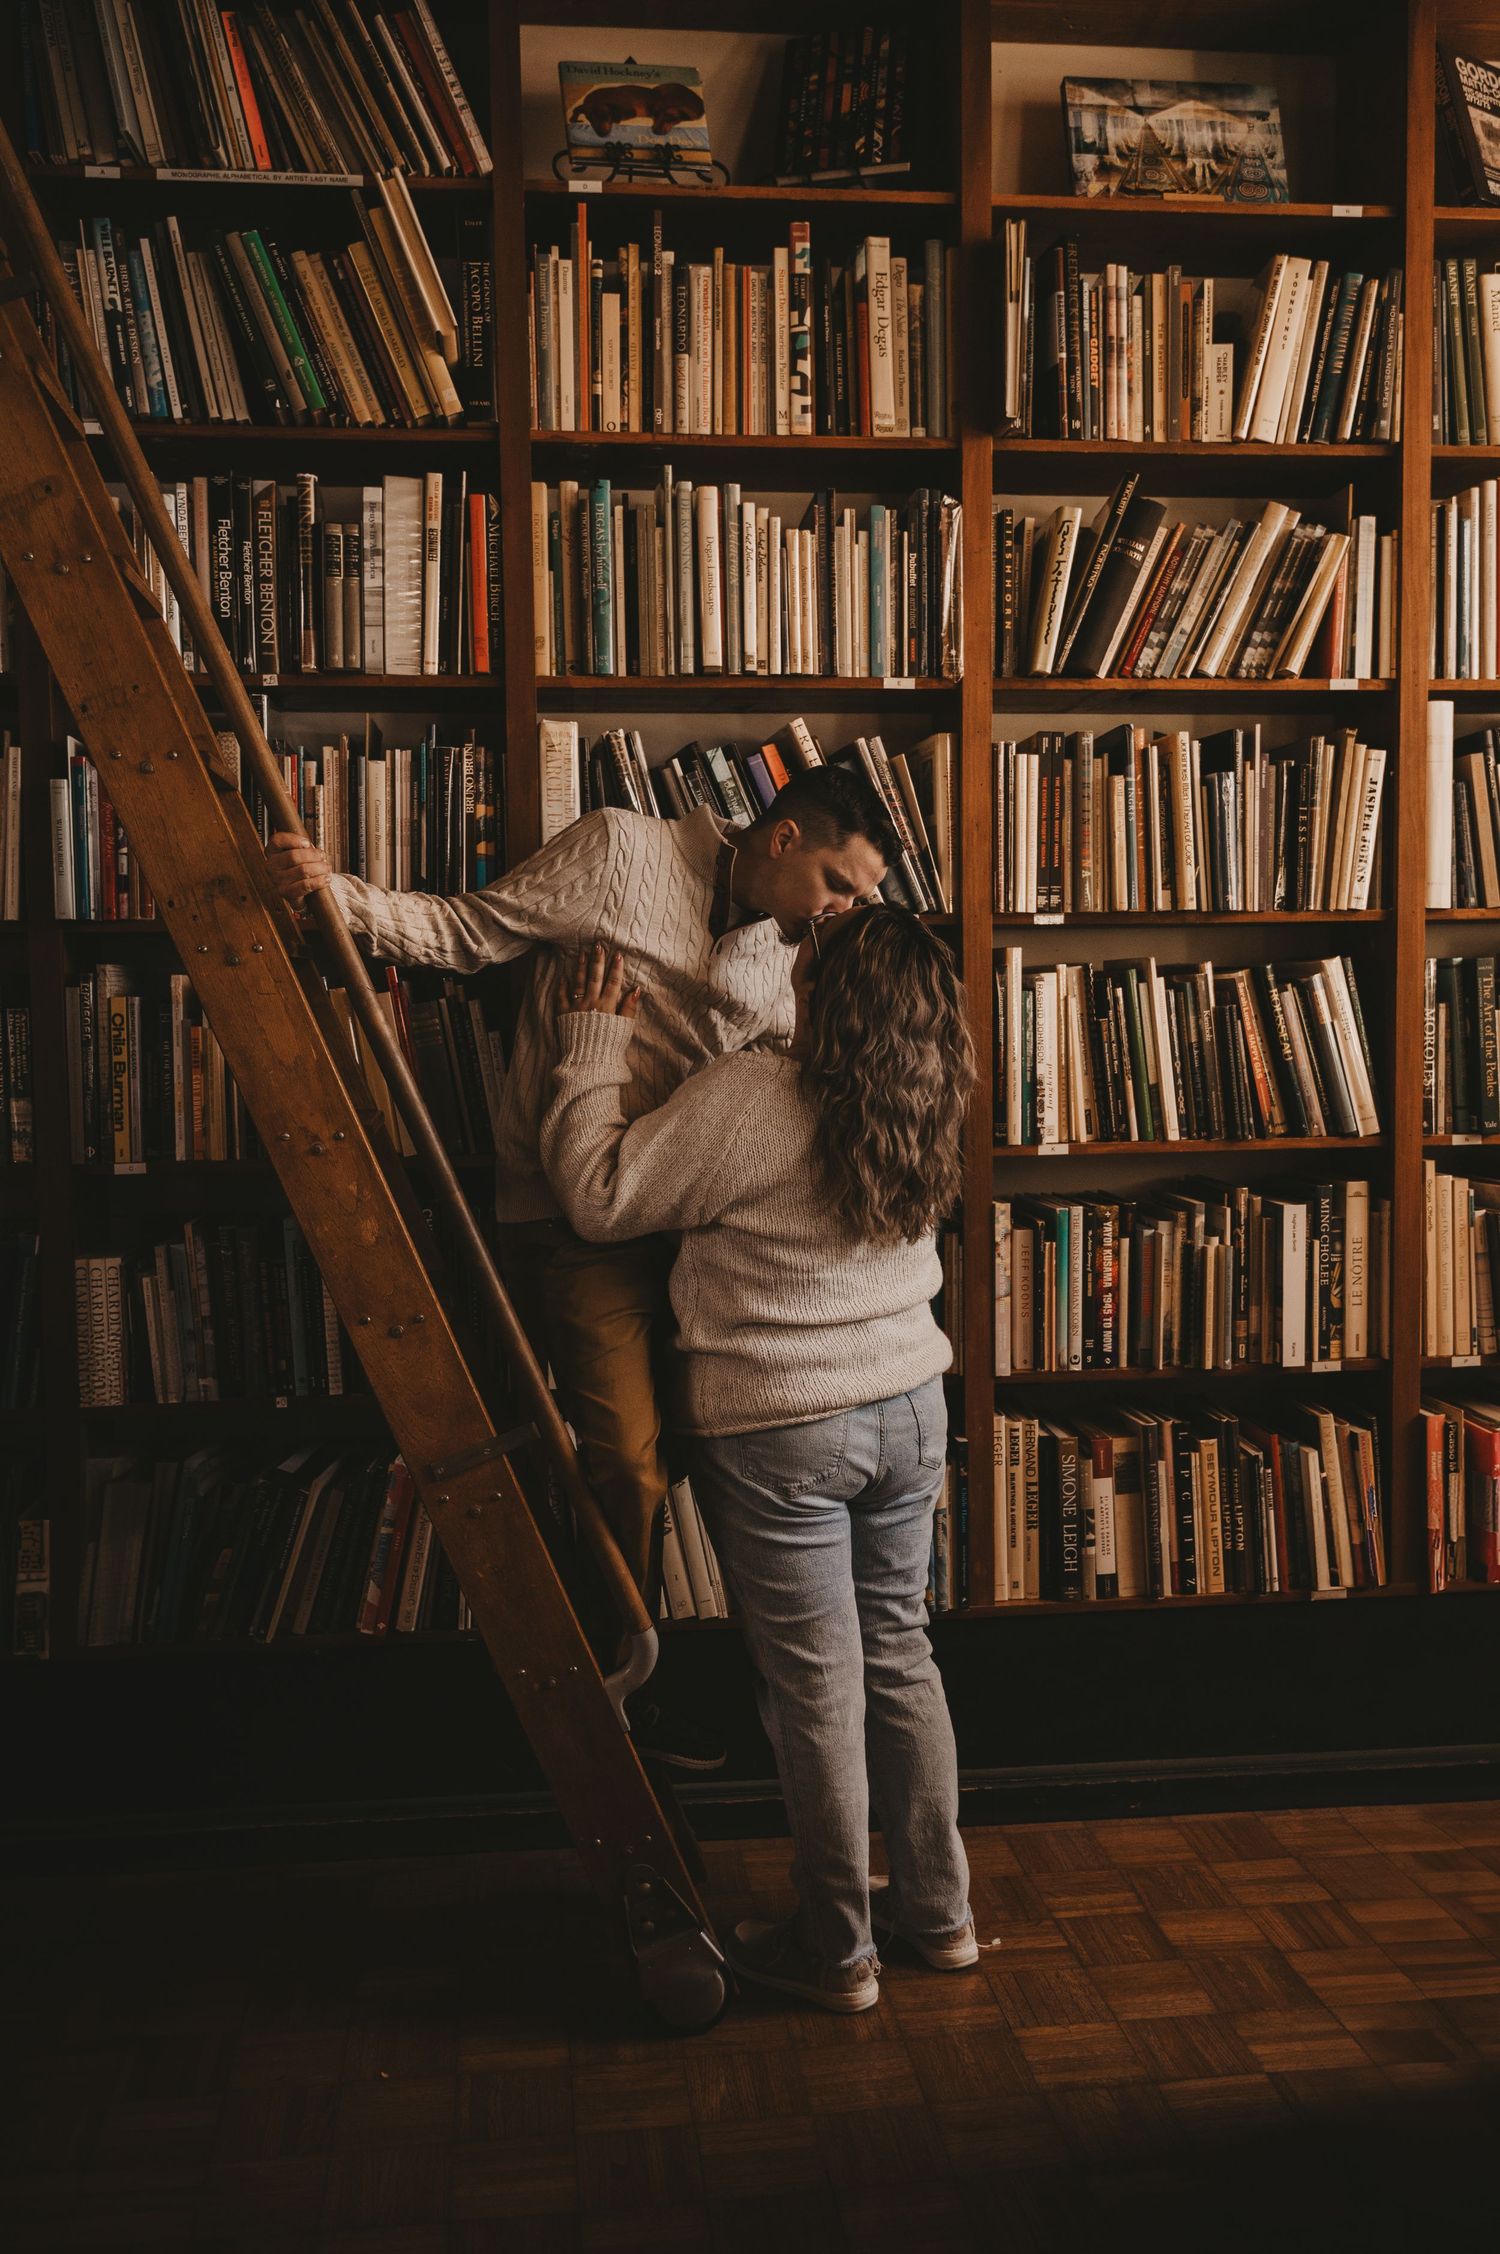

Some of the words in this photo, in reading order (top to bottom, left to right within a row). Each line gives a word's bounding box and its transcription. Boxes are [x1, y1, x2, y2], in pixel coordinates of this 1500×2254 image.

[566, 66, 601, 76] David
[605, 66, 661, 83] Hockney's
[98, 224, 114, 249] WILL
[102, 250, 119, 297] BARNET
[468, 260, 483, 311] JACOPO
[482, 261, 490, 276] THE
[540, 262, 550, 302] Daumier
[561, 266, 569, 295] Daumier
[778, 268, 787, 295] Stuart
[1067, 242, 1080, 317] FREDERICK
[1272, 263, 1284, 277] THE
[1447, 264, 1460, 307] MANET
[1464, 264, 1477, 307] MANET
[482, 278, 491, 310] GENIUS
[760, 278, 768, 303] DAVIS'S
[872, 272, 888, 312] Edgar
[1267, 279, 1280, 300] MOST
[483, 311, 491, 323] OF
[676, 285, 687, 352] LEONARDO
[760, 305, 768, 340] ABSTRACT
[778, 297, 787, 322] Davis
[1260, 313, 1272, 335] JOHN
[1265, 301, 1274, 313] OF
[1280, 271, 1300, 352] SOUNDINGS
[1490, 289, 1500, 333] Manet
[471, 315, 484, 368] BELLINI
[540, 305, 552, 350] Drawings
[779, 323, 787, 360] American
[874, 316, 890, 358] Degas
[1070, 320, 1081, 362] HART
[1158, 322, 1166, 342] Tim
[1385, 304, 1398, 350] HOKUSAI'S
[760, 341, 768, 365] ARGOT
[1255, 335, 1267, 356] HELD
[779, 361, 788, 391] Painter
[1158, 348, 1166, 393] Hawkinson
[1381, 352, 1393, 409] LANDSCAPES
[680, 497, 691, 514] DE
[1115, 479, 1136, 516] HOGARTH
[298, 479, 314, 566] BERNINI
[532, 512, 541, 538] EDGAR
[552, 519, 560, 541] Degas
[594, 502, 606, 541] DEGAS
[217, 518, 234, 570] Fletcher
[242, 540, 254, 573] Fletcher
[488, 522, 502, 580] MICHAEL
[532, 541, 541, 568] DEGAS
[594, 543, 607, 554] by
[680, 518, 693, 575] KOONING
[704, 535, 716, 562] Degas
[596, 556, 609, 592] himself
[908, 552, 918, 588] Dubuffet
[1004, 515, 1015, 631] HIRSHHORN
[1086, 543, 1111, 590] ENGRAVINGS
[168, 586, 178, 621] andscape
[218, 570, 234, 619] Benton
[243, 573, 255, 606] Benton
[488, 583, 502, 622] BIRCH
[706, 565, 718, 617] Landscapes
[909, 588, 917, 598] as
[909, 599, 918, 630] architect
[463, 743, 475, 774] BRUNI
[545, 739, 564, 808] MARCEL
[463, 776, 475, 815] BRUNO
[944, 759, 956, 821] Impossible
[1040, 776, 1048, 787] THE
[1053, 776, 1061, 787] THE
[1040, 788, 1048, 818] ESSENTIAL
[1053, 788, 1061, 818] ESSENTIAL
[1127, 787, 1137, 823] INGRES
[1362, 778, 1379, 833] JASPER
[56, 818, 65, 850] WILLIAM
[1040, 820, 1048, 842] ROBERT
[1053, 820, 1061, 842] ROBERT
[1159, 800, 1167, 841] HIDEAWAYS
[1298, 806, 1308, 845] JESS
[947, 824, 957, 863] Worlds
[1040, 843, 1048, 869] INDIANA
[1053, 843, 1061, 868] INDIANA
[1355, 836, 1372, 885] JOHNS
[57, 851, 66, 877] BIRCH
[1036, 983, 1045, 1019] RASHID
[1237, 981, 1250, 1007] Sarah
[1483, 973, 1498, 999] The
[1202, 1009, 1213, 1043] Kienholz
[1242, 1007, 1255, 1031] Lucas
[1268, 987, 1294, 1063] ROUSSEAU
[1484, 1001, 1497, 1022] Art
[112, 1012, 126, 1056] Chila
[1036, 1021, 1045, 1065] JOHNSON
[1246, 1033, 1259, 1061] HAPPY
[1423, 1007, 1436, 1088] MOROLES
[1485, 1024, 1497, 1037] of
[1485, 1038, 1498, 1059] the
[1252, 1061, 1263, 1080] GAS
[1486, 1061, 1499, 1098] Peales
[112, 1060, 127, 1133] Burman
[1483, 1119, 1498, 1128] Yale
[1426, 1178, 1434, 1204] Georgia
[1072, 1213, 1081, 1230] THE
[1319, 1198, 1331, 1231] MING
[1427, 1205, 1435, 1233] O'Keeffe
[1072, 1232, 1081, 1261] PRINTS
[1102, 1220, 1113, 1248] YAYOI
[1319, 1233, 1331, 1261] CHO
[1020, 1243, 1031, 1272] JEFF
[1072, 1263, 1081, 1276] OF
[1102, 1249, 1113, 1289] KUSAMA
[1320, 1262, 1331, 1286] LEE
[1020, 1274, 1031, 1320] KOONS
[1072, 1277, 1081, 1310] MARIAN
[1102, 1292, 1113, 1315] 1945
[1072, 1312, 1081, 1337] KORN
[1103, 1316, 1113, 1330] TO
[1103, 1330, 1113, 1353] NOW
[993, 1429, 1003, 1467] LEGER
[1009, 1427, 1021, 1468] LEGER
[1448, 1423, 1459, 1460] Picasso
[1061, 1453, 1076, 1518] SIMONE
[1206, 1451, 1218, 1523] SEYMOUR
[1221, 1466, 1229, 1503] SEYMOUR
[1233, 1466, 1241, 1503] SEYMOUR
[1150, 1479, 1160, 1566] LEYENDECKER
[1222, 1503, 1233, 1550] LIPTON
[1234, 1504, 1246, 1551] LIPTON
[1062, 1523, 1078, 1573] LEIGH
[1210, 1526, 1221, 1578] LIPTON
